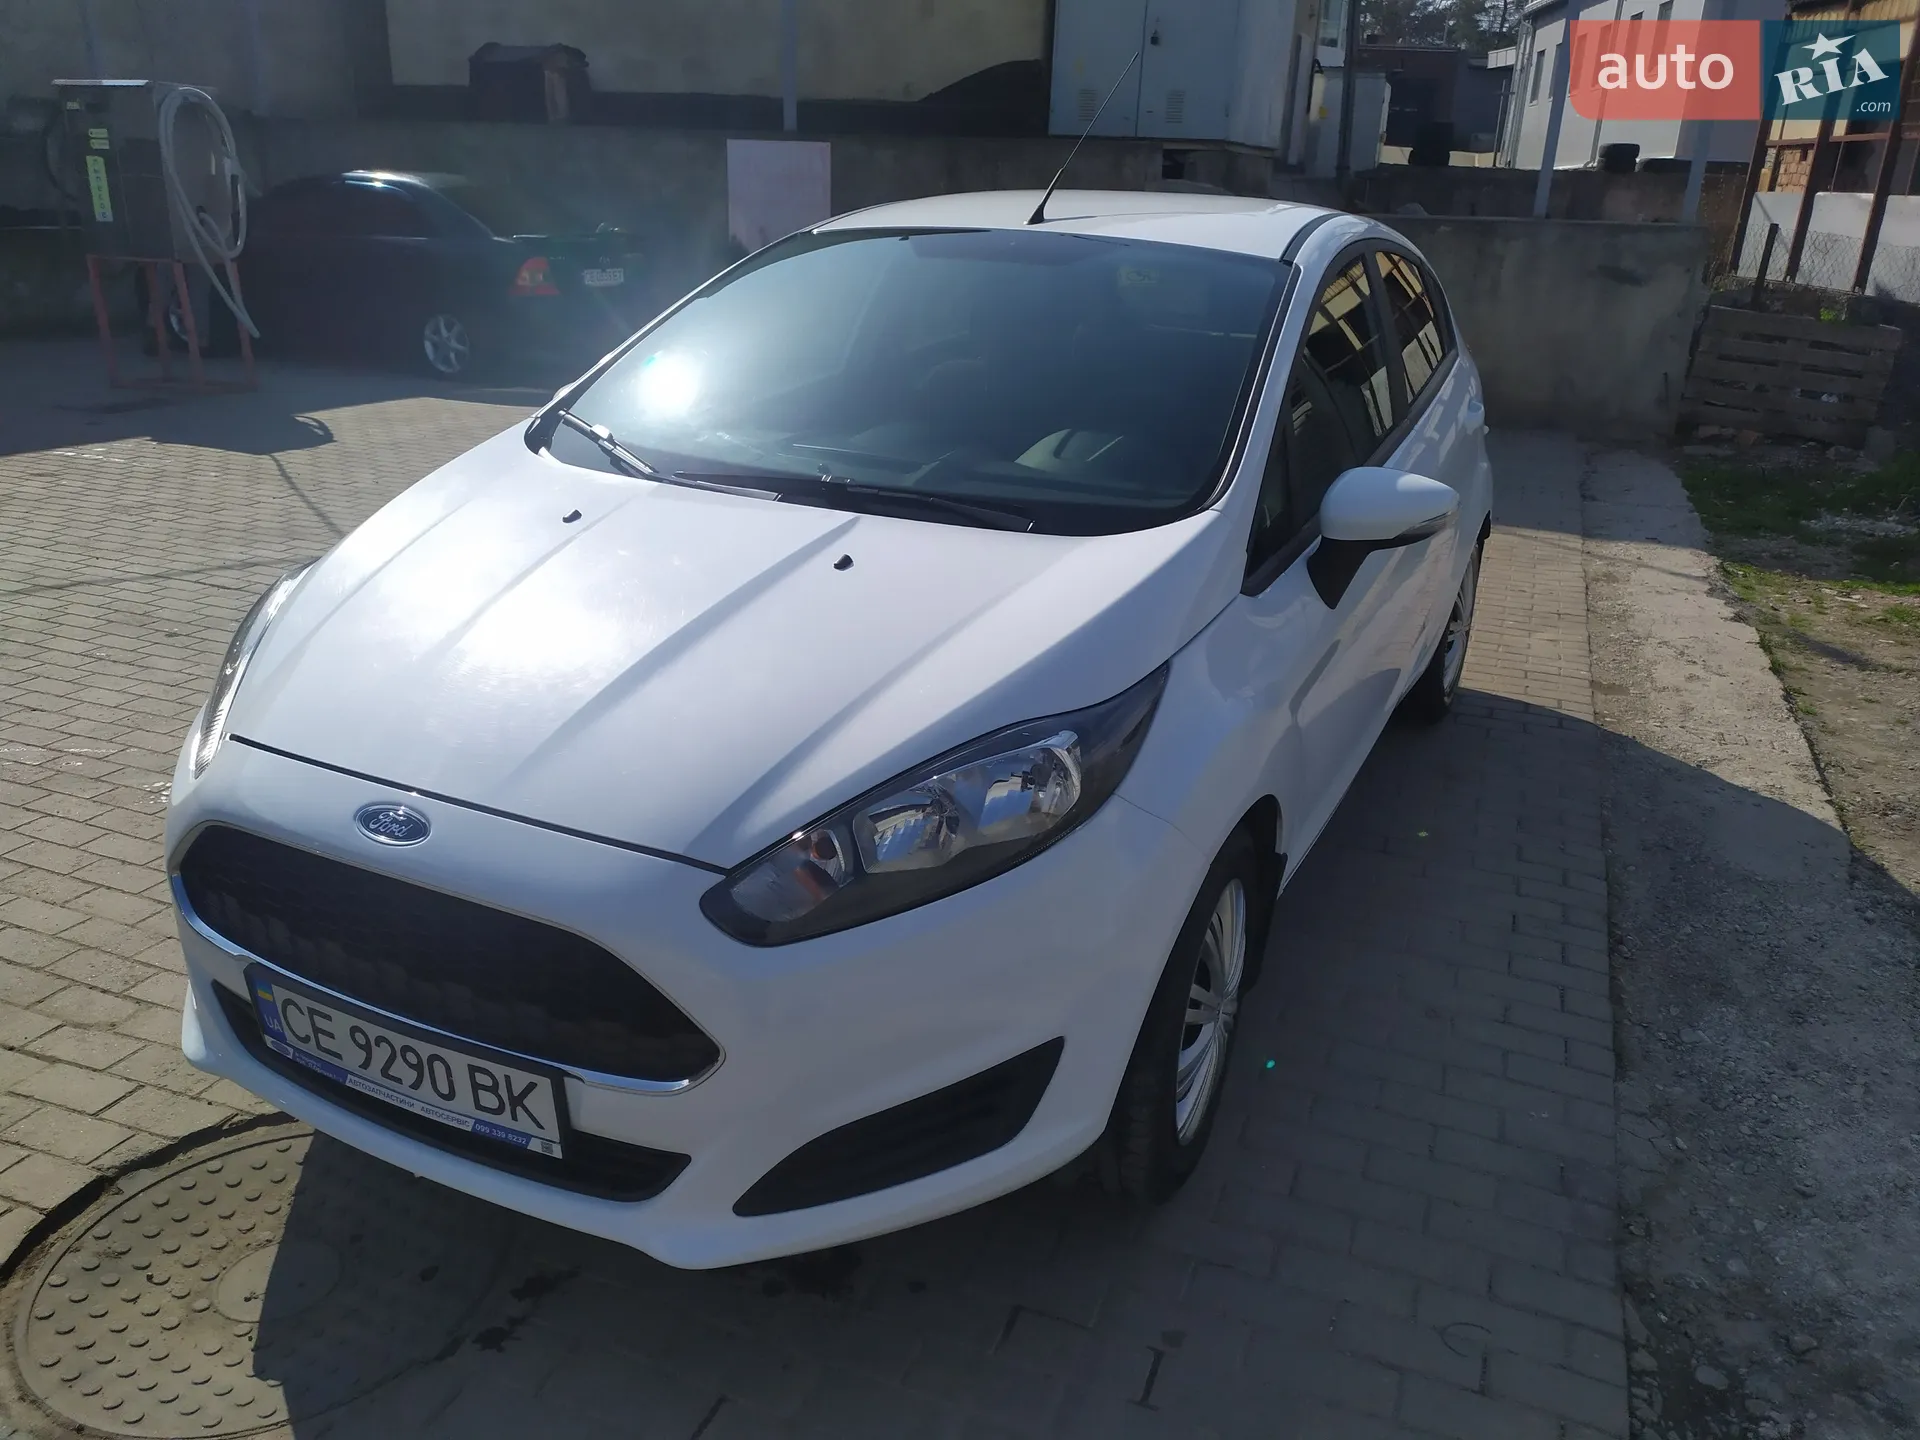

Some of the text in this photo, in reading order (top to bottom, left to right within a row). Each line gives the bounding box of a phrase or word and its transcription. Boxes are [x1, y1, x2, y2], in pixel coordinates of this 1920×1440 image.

[369, 811, 413, 837] Ford
[264, 1013, 283, 1033] UA
[281, 998, 546, 1131] CE 9290 BK
[348, 1078, 471, 1128] АВТОЗАПЧАСТИНИ АВТОСЕРВІС
[475, 1123, 527, 1145] 099 339 8232
